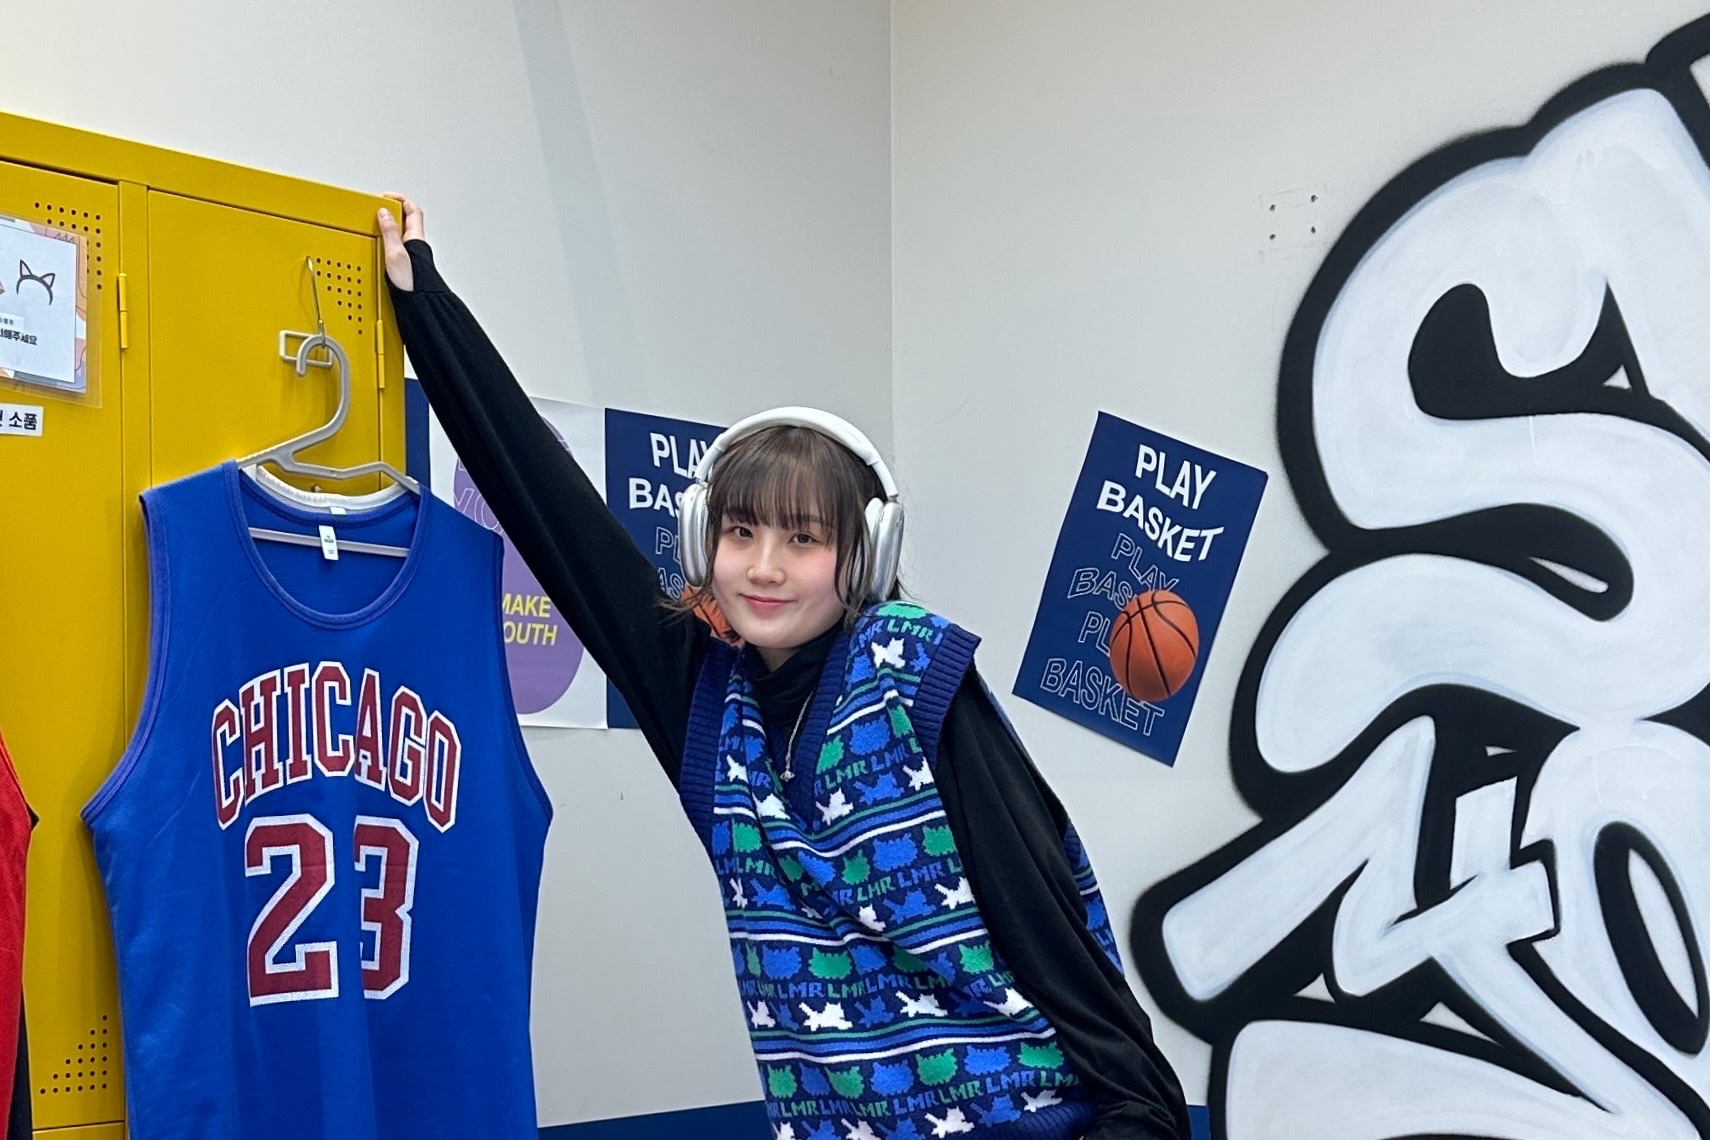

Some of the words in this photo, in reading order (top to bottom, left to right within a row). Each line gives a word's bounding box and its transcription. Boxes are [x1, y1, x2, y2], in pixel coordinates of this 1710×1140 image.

[9, 411, 38, 431] 소품
[1135, 444, 1217, 510] PLAY
[1096, 480, 1225, 562] BASKET
[1067, 567, 1138, 611] BAS
[503, 620, 558, 646] OUTH
[886, 619, 934, 642] LMR
[1041, 657, 1165, 736] BASKET
[211, 661, 462, 833] CHICAGO
[824, 760, 869, 789] LMR
[870, 743, 910, 772] LMR
[857, 876, 896, 901] LMR
[896, 861, 947, 888] LMR
[244, 813, 420, 1008] 23
[777, 982, 826, 999] LMR
[827, 980, 866, 999] LMR
[865, 973, 913, 993] LMR
[780, 1100, 820, 1118] LMR
[850, 1100, 892, 1118] LMR
[892, 1091, 940, 1115] LMR
[937, 1080, 984, 1104] LMR
[985, 1070, 1038, 1094] LMR
